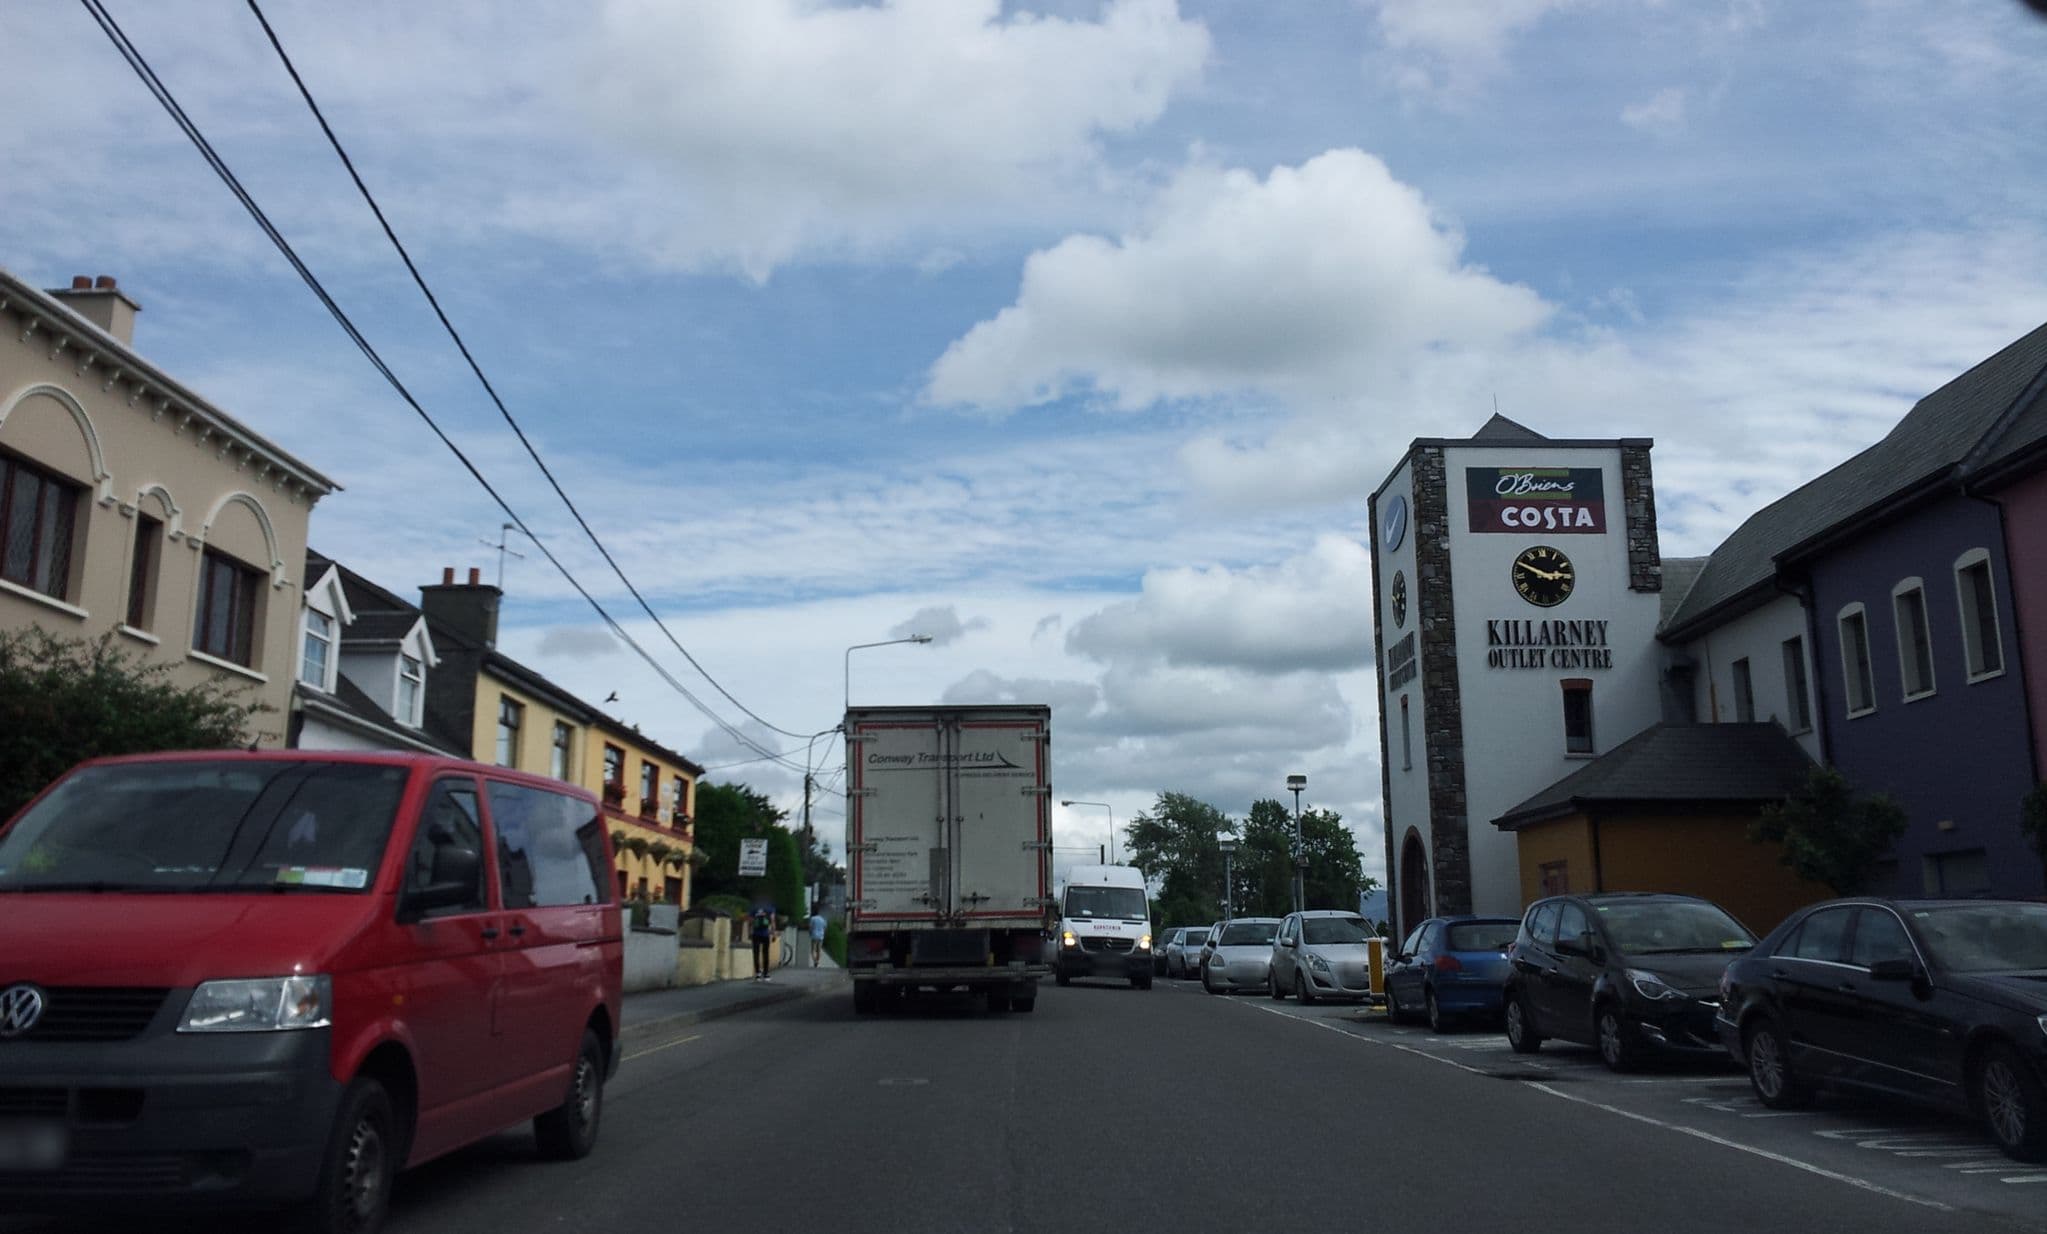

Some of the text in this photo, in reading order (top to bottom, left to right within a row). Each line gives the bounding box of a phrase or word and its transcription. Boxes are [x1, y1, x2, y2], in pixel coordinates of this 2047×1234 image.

[1495, 473, 1576, 495] O'Briens
[1501, 506, 1595, 529] COSTA
[1487, 620, 1608, 646] KILLARNEY
[1488, 648, 1612, 669] OUTLET CENTRE
[868, 753, 915, 765] Conway
[976, 752, 994, 762] Ltd
